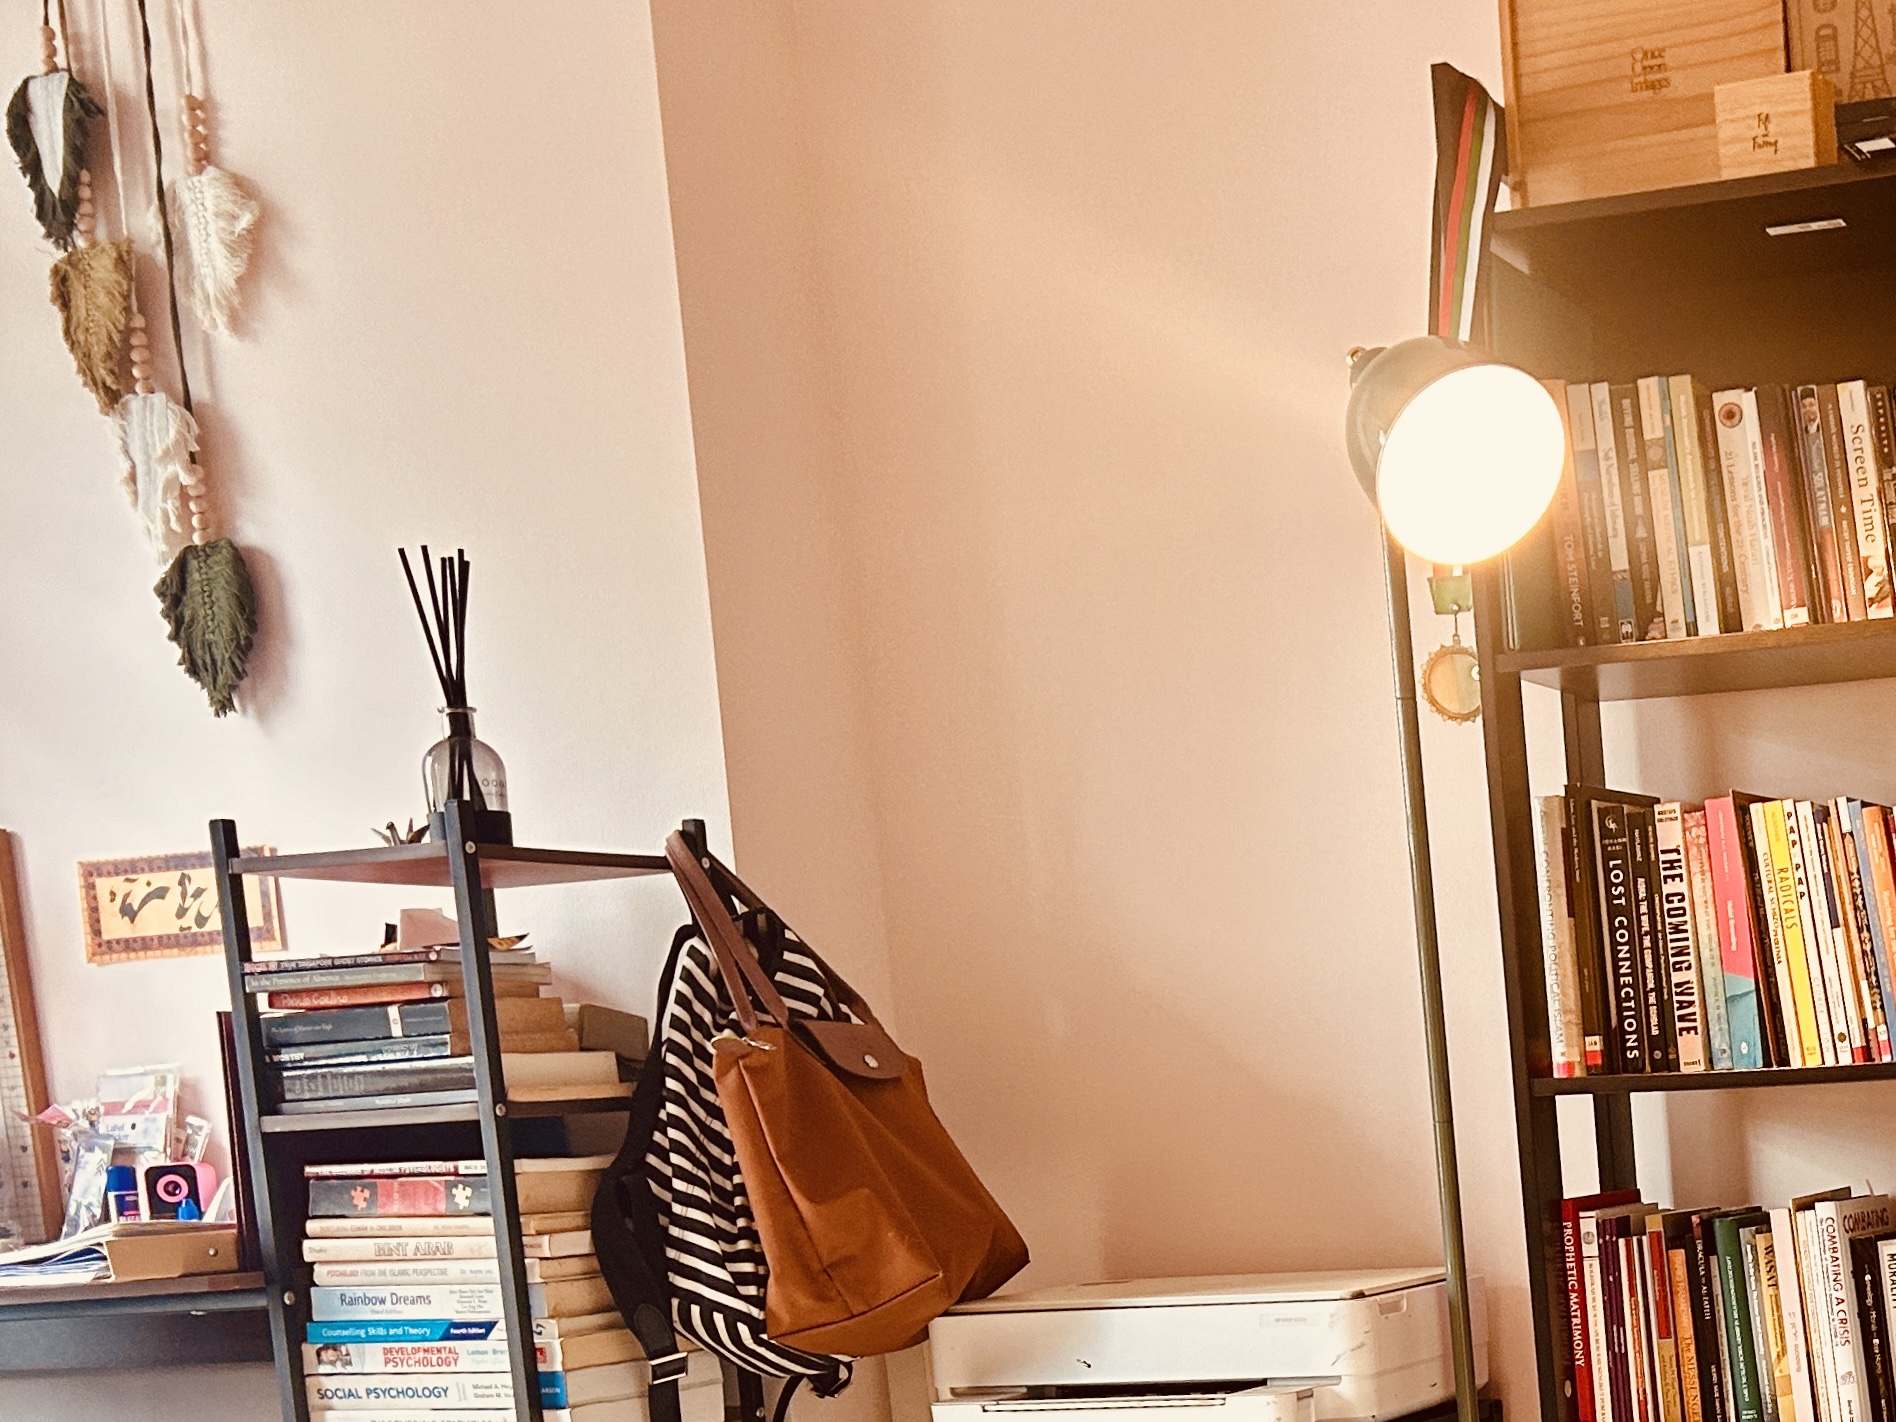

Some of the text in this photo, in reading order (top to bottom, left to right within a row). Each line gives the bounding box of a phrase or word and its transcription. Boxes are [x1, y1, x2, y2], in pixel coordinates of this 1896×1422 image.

[1850, 424, 1878, 544] Screen Time
[1726, 463, 1737, 502] Lessons
[1737, 552, 1750, 594] Century
[1563, 535, 1584, 627] TOM STEINFORT
[1660, 846, 1683, 885] THE
[1777, 867, 1797, 931] RADICALS
[1666, 892, 1692, 973] COMING
[1609, 859, 1639, 1060] LOST CONNECTIONS
[1674, 980, 1698, 1037] WAVE
[373, 1242, 454, 1256] BINT ARAB
[1562, 1221, 1578, 1290] PROPHETIC
[1763, 1241, 1777, 1290] WASAT
[1825, 1217, 1839, 1294] COMBATING
[340, 1293, 432, 1307] Rainbow Dreams
[1834, 1296, 1843, 1306] A
[322, 1326, 431, 1338] Counselling Skills and Theory
[382, 1346, 460, 1356] DEVELOPMENTAL
[1569, 1292, 1584, 1368] MATRIMONY
[1682, 1335, 1694, 1353] The
[1836, 1310, 1851, 1347] CRISIS
[383, 1356, 459, 1368] PSYCHOLOGY
[317, 1386, 449, 1400] SOCIAL PSYCHOLOGY
